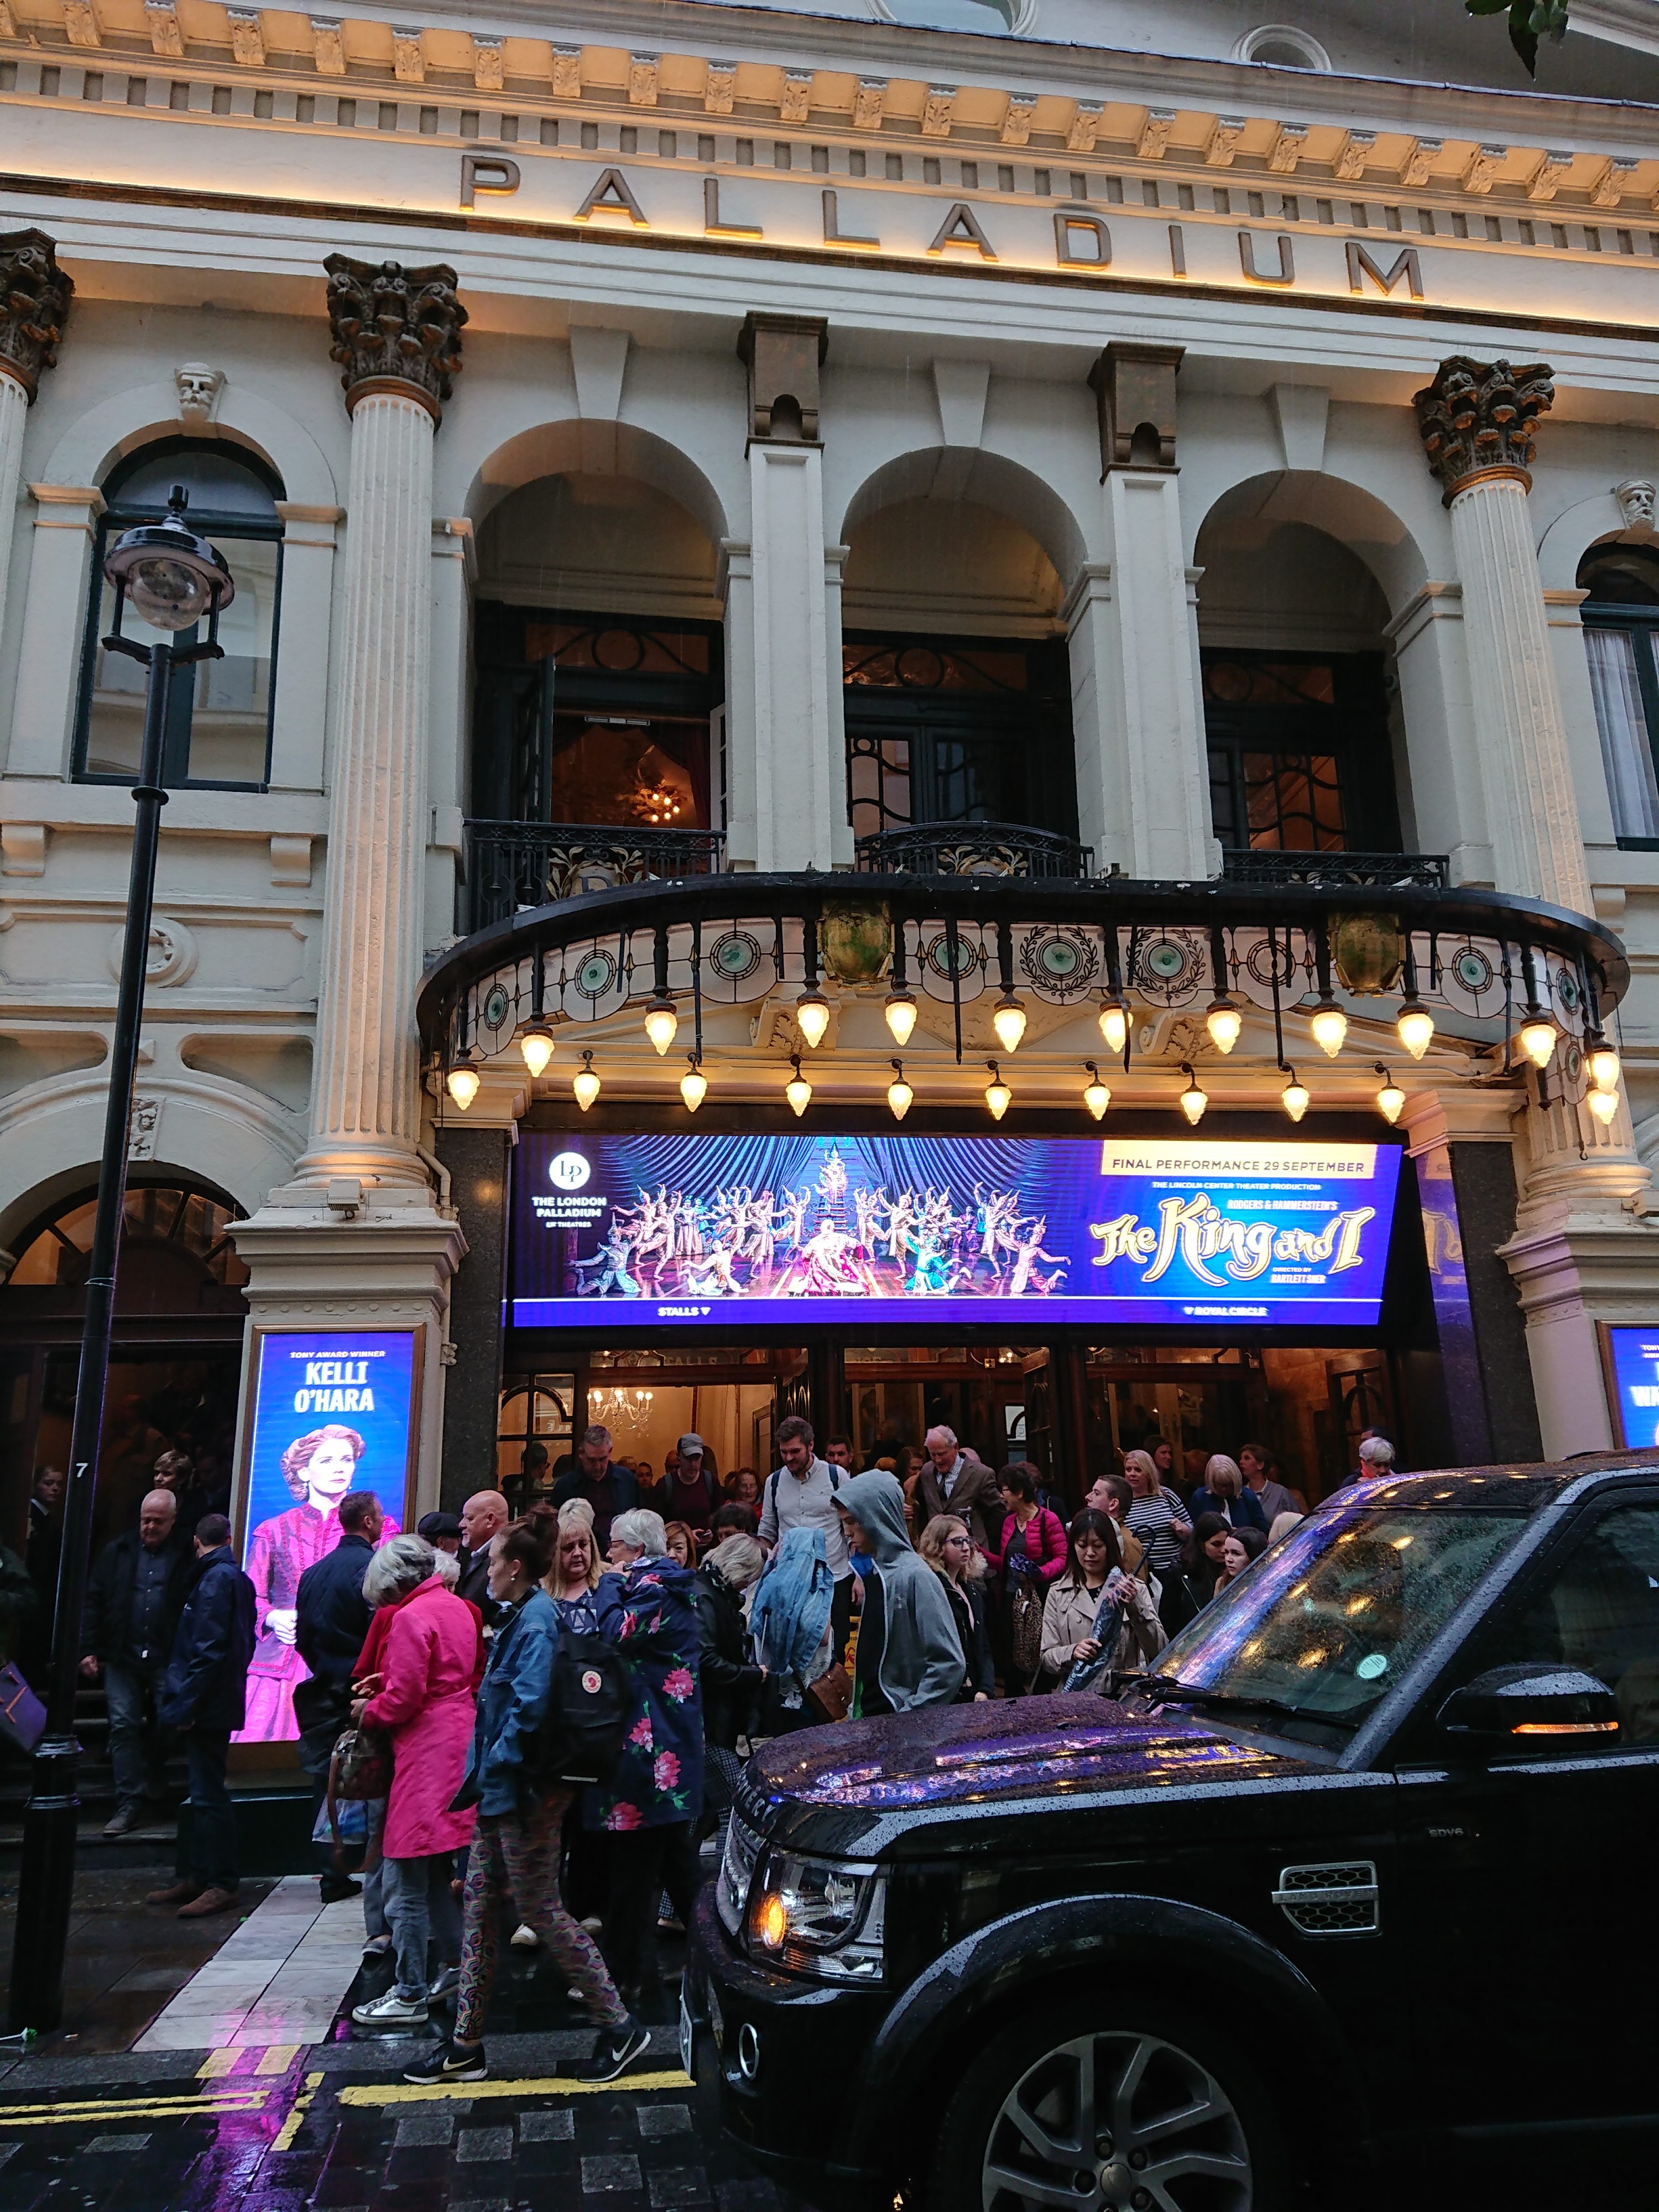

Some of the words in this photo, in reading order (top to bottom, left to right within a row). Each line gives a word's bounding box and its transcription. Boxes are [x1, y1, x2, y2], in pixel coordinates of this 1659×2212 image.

[460, 154, 1425, 300] PALLADIUM
[1112, 1159, 1152, 1168] FINAL
[1156, 1160, 1260, 1170] PERFORMANCE
[1264, 1161, 1279, 1171] 29
[1282, 1161, 1364, 1172] SEPTEMBER
[531, 1197, 555, 1206] THE
[557, 1197, 607, 1207] LONDON
[1227, 1199, 1264, 1209] RODGERS
[1264, 1200, 1272, 1210] &
[1272, 1200, 1339, 1211] HAMMERSTEIN'S
[536, 1208, 602, 1217] PALLADIUM
[1091, 1214, 1157, 1266] The
[1141, 1192, 1277, 1287] King
[1275, 1218, 1340, 1263] and
[1327, 1206, 1376, 1274] I
[1271, 1274, 1307, 1284] BARTLETT
[658, 1307, 700, 1317] STALLS
[1194, 1307, 1229, 1316] ROYAL
[1229, 1307, 1269, 1317] CIRCLE
[305, 1361, 369, 1385] KELLI
[294, 1388, 375, 1413] O'HARA
[76, 1463, 88, 1478] 7
[1428, 1827, 1464, 1838] SDV6
[1279, 1892, 1319, 1902] LAND
[1325, 1888, 1374, 1900] ROVER
